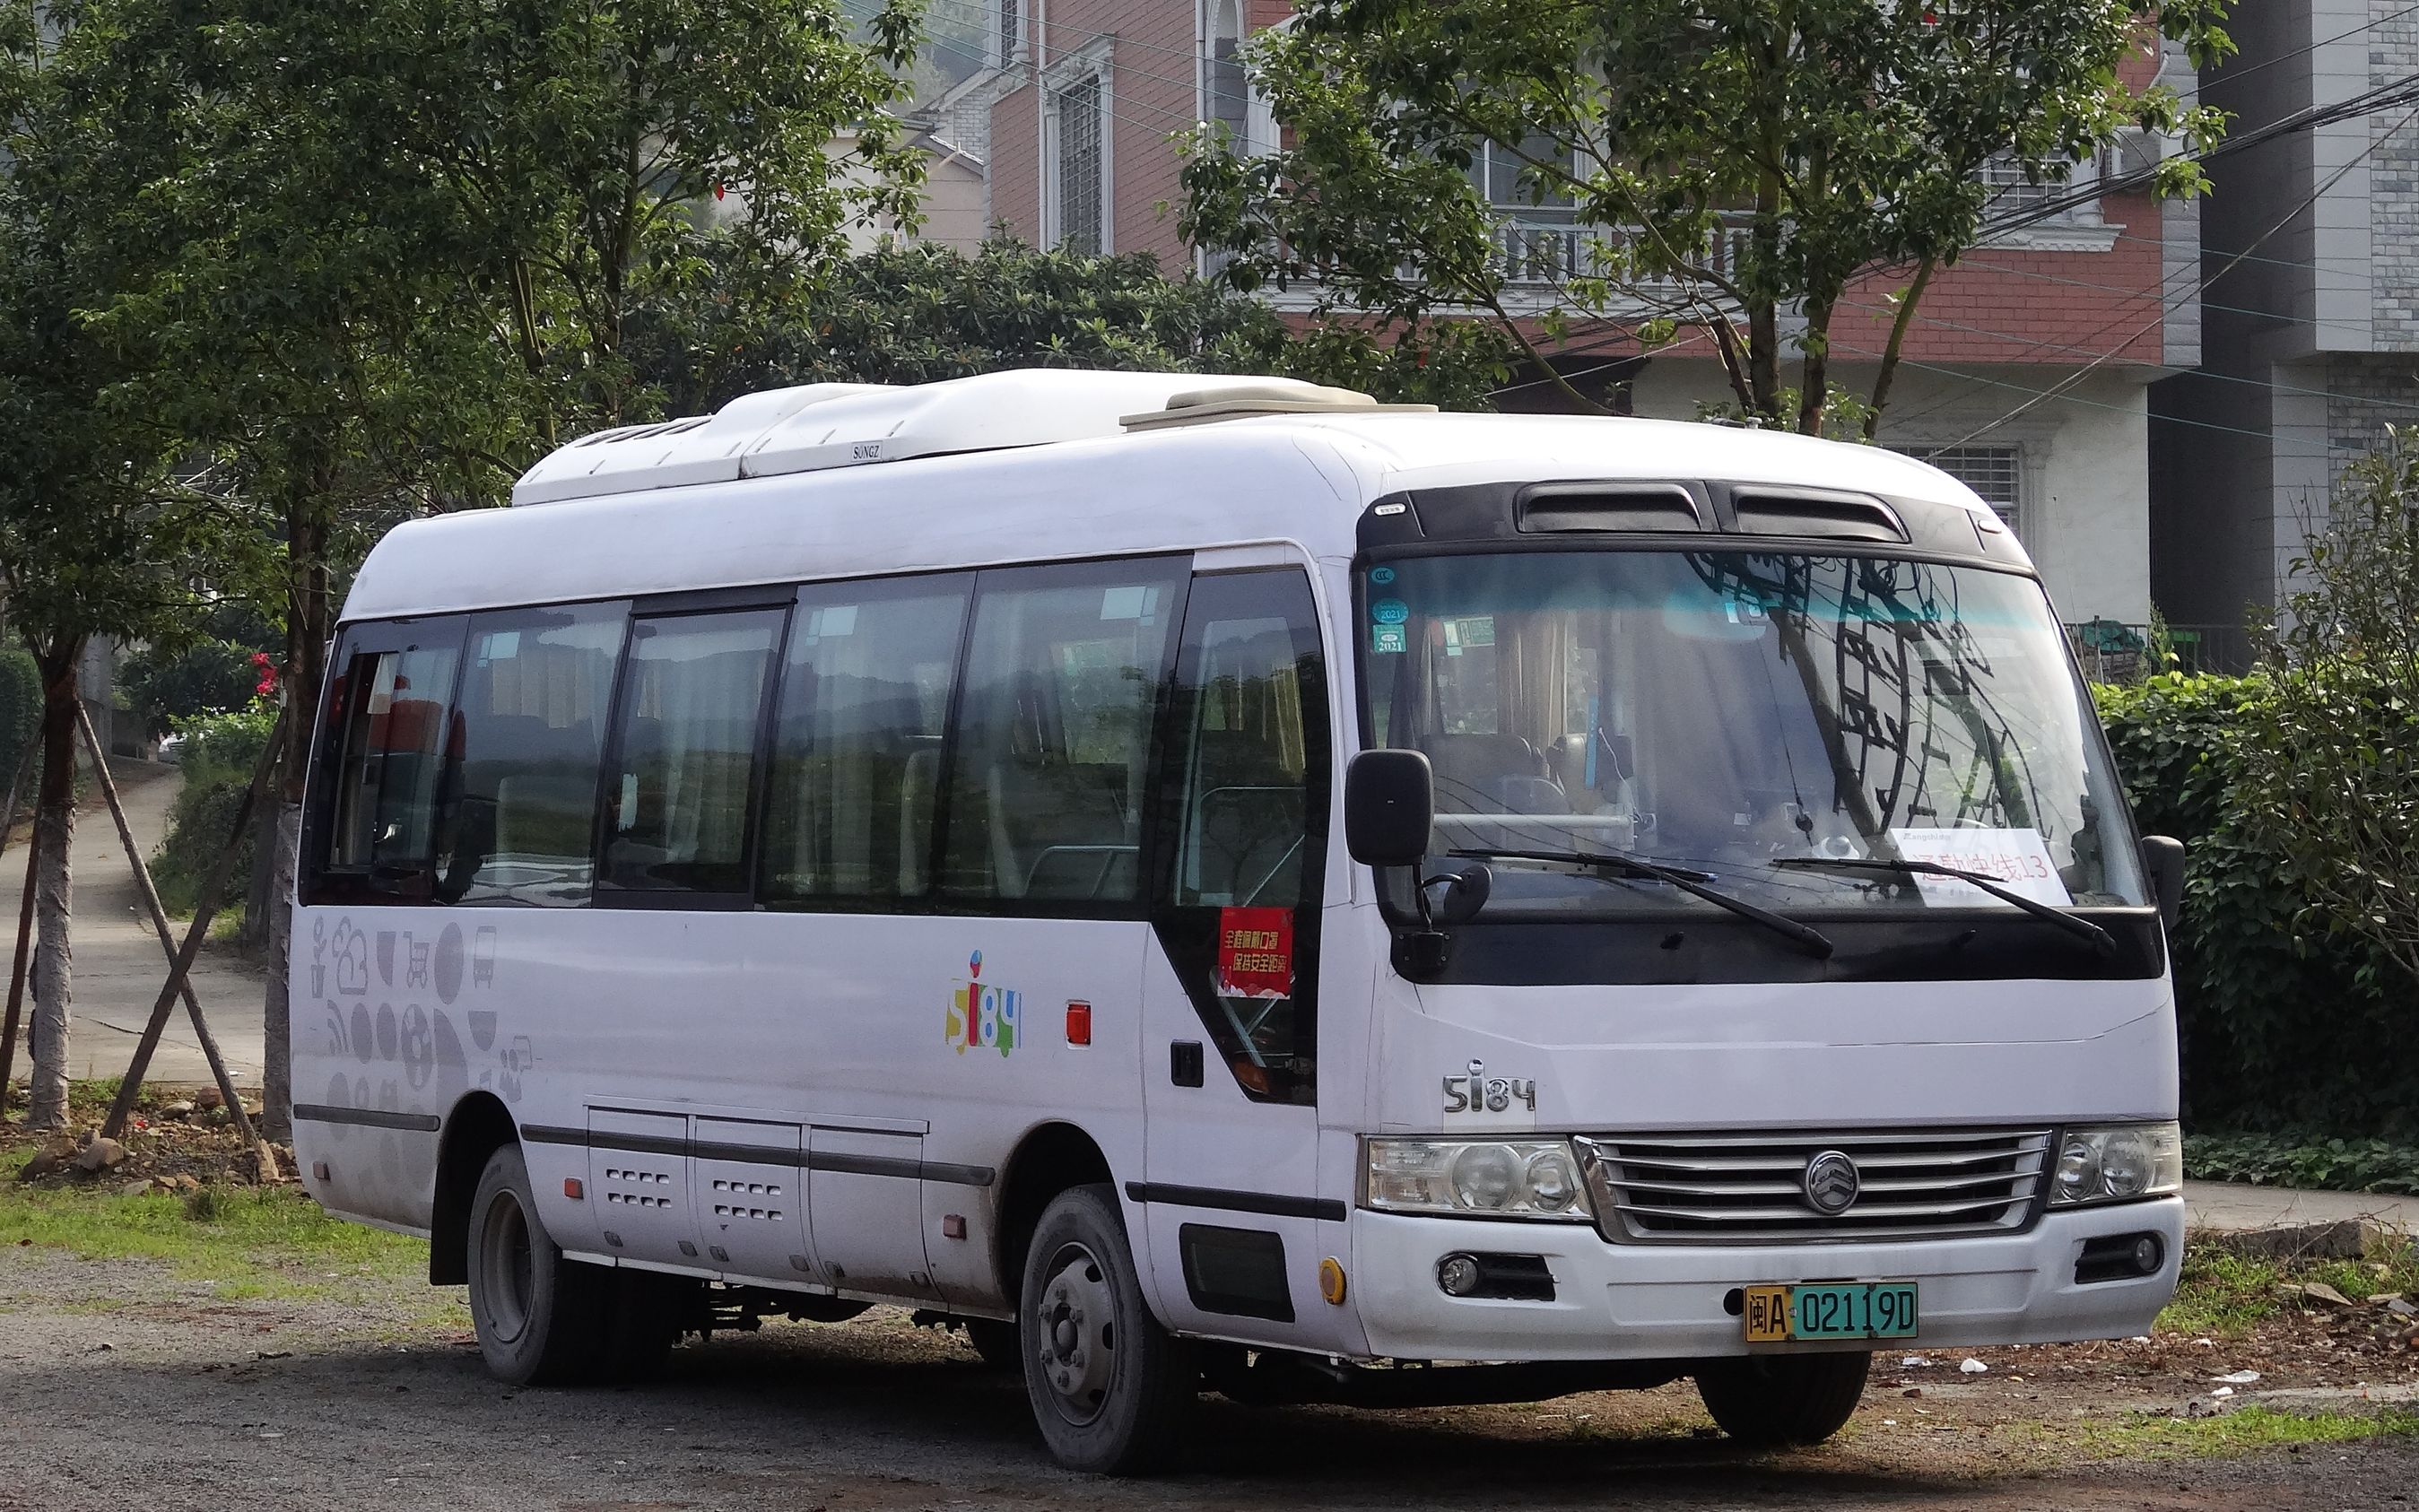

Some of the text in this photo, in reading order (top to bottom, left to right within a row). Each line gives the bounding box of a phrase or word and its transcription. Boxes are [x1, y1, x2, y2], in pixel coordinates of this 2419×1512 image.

[853, 445, 880, 459] SONGZ
[1380, 610, 1401, 619] 2021
[1379, 641, 1402, 652] 2021
[1232, 952, 1288, 973] 保持安全距离
[1802, 1290, 1915, 1333] 02119D
